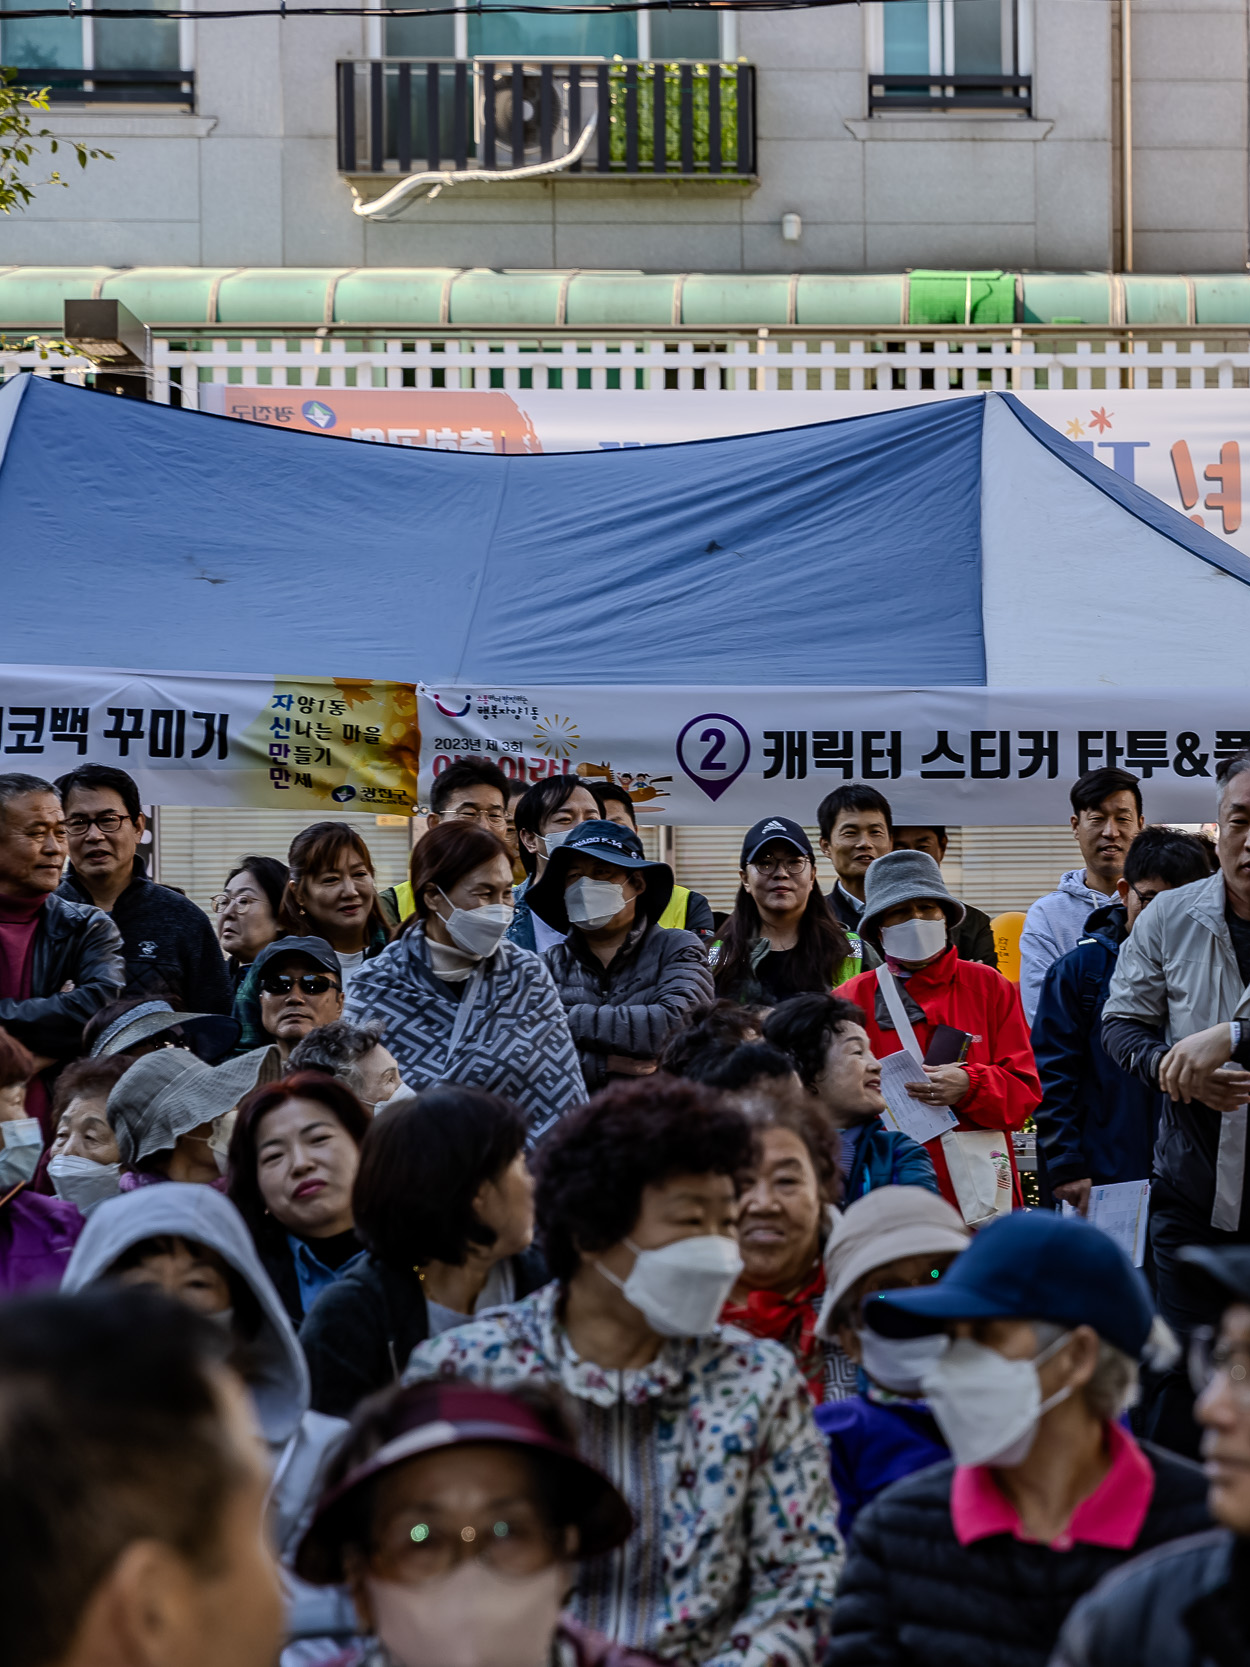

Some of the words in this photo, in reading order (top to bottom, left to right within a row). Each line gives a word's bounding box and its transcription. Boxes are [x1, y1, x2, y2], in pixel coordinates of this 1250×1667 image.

[271, 694, 347, 717] 자양1동
[0, 707, 90, 756] 코백
[103, 707, 230, 760] 꾸미기
[269, 717, 333, 741] 신나는
[342, 723, 382, 745] 마을
[269, 743, 332, 766] 만들기
[434, 738, 482, 752] 2023년
[485, 739, 499, 752] 제
[502, 741, 524, 754] 3회
[699, 728, 727, 771] 2
[763, 730, 902, 780] 캐릭터
[920, 730, 1059, 780] 스티커
[270, 768, 313, 790] 만세
[360, 786, 408, 800] 광진구
